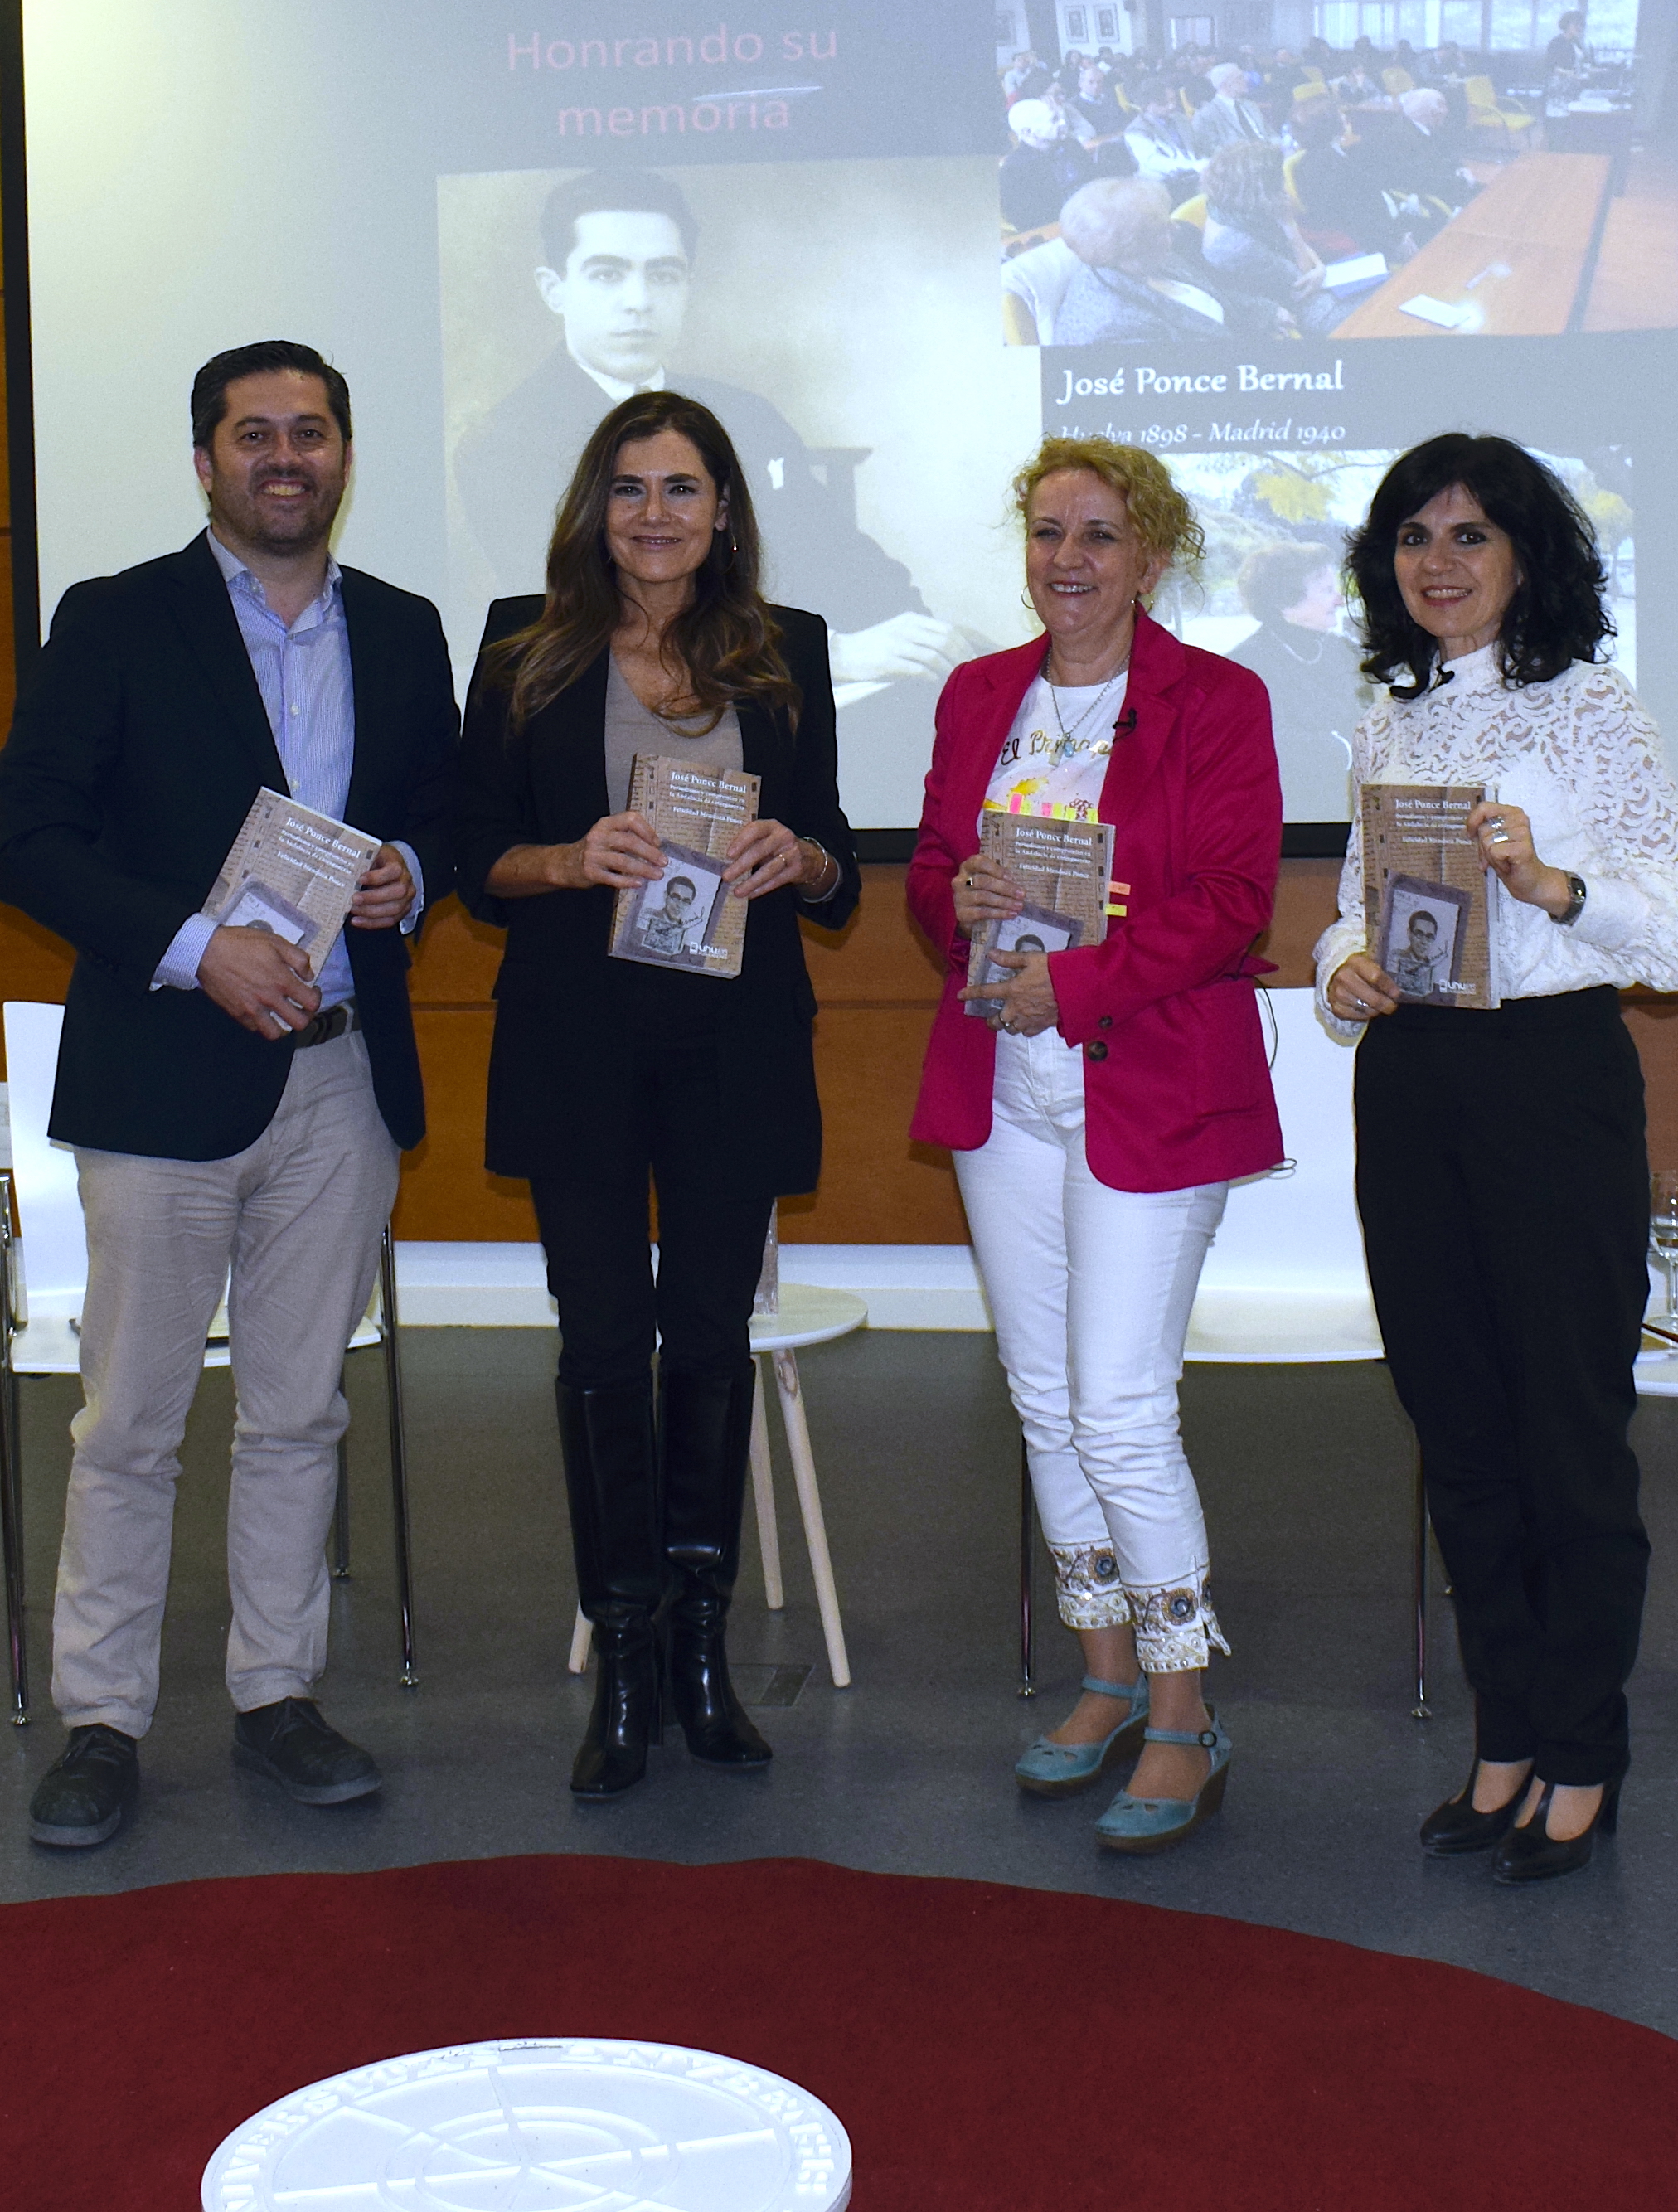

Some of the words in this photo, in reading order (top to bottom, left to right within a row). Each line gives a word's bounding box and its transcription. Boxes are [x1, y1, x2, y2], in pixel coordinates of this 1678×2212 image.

[507, 23, 764, 70] Honrando
[782, 30, 837, 61] su
[558, 93, 789, 137] memoria
[1055, 367, 1125, 405] José
[1135, 367, 1227, 394] Ponce
[1237, 360, 1345, 392] Bernal
[1141, 424, 1188, 449] 1898
[1209, 418, 1292, 442] Madrid
[1298, 426, 1346, 444] 1940
[1001, 738, 1021, 765] El
[672, 771, 689, 783] José
[691, 775, 716, 787] Ponce
[719, 780, 746, 793] Bernal
[1395, 798, 1413, 809] José
[1414, 799, 1440, 808] Ponce
[1443, 800, 1471, 809] Bernal
[286, 817, 303, 832] José
[305, 826, 331, 844] Ponce
[332, 839, 361, 858] Bernal
[1016, 827, 1034, 837] José
[1036, 830, 1061, 842] Ponce
[1063, 834, 1092, 846] Bernal
